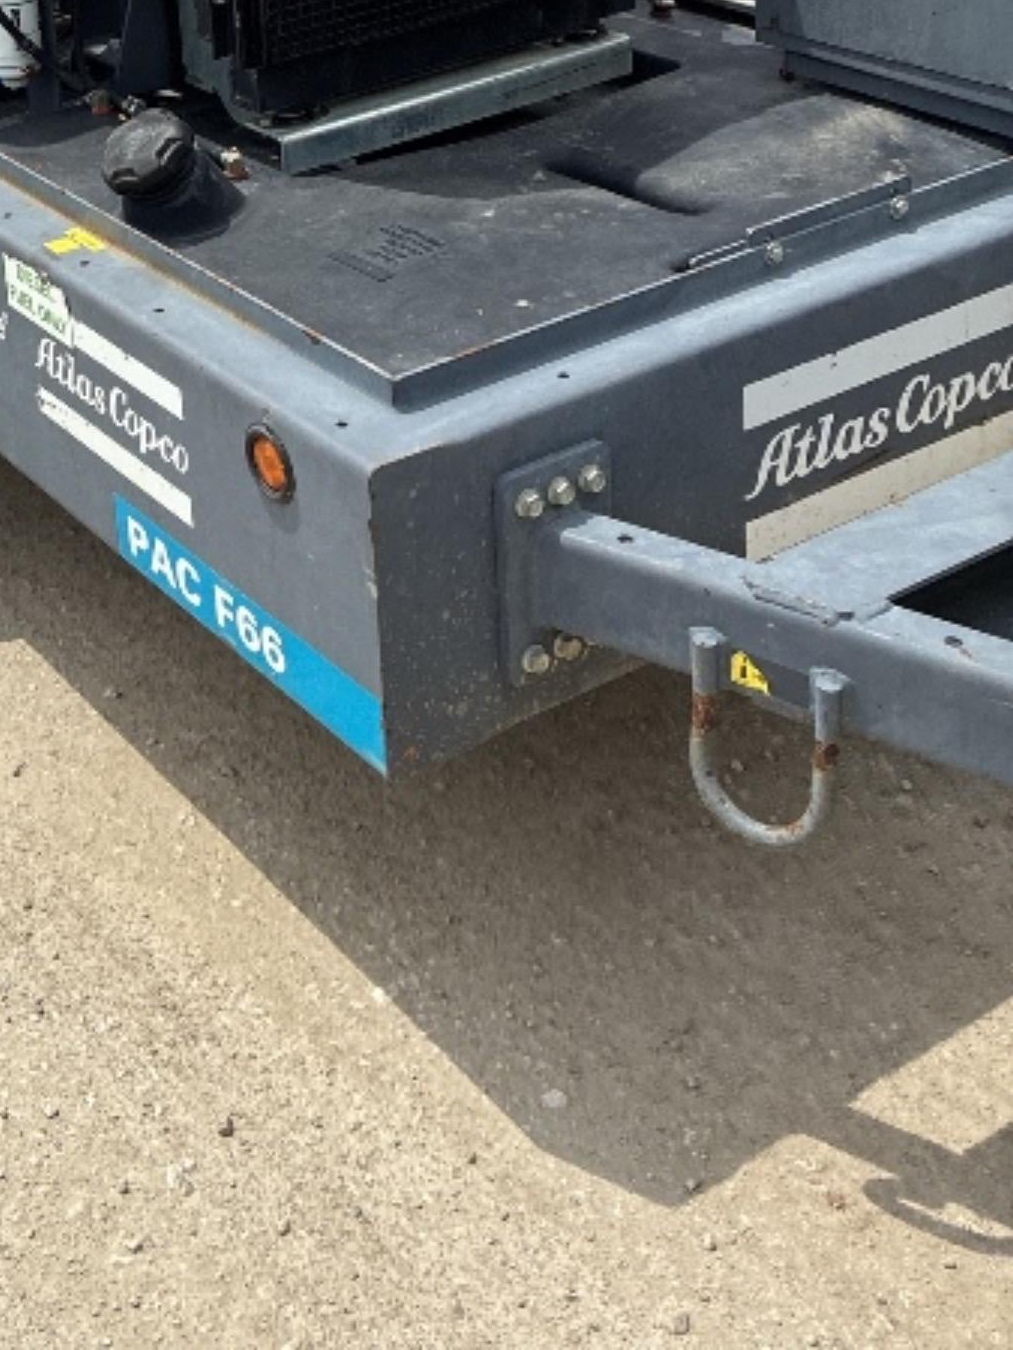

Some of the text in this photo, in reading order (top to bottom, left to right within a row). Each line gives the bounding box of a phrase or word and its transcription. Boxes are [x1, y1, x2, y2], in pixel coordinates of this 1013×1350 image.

[35, 338, 189, 474] Atlas Copco
[745, 407, 891, 501] Atlas
[126, 514, 286, 674] PAC F66
